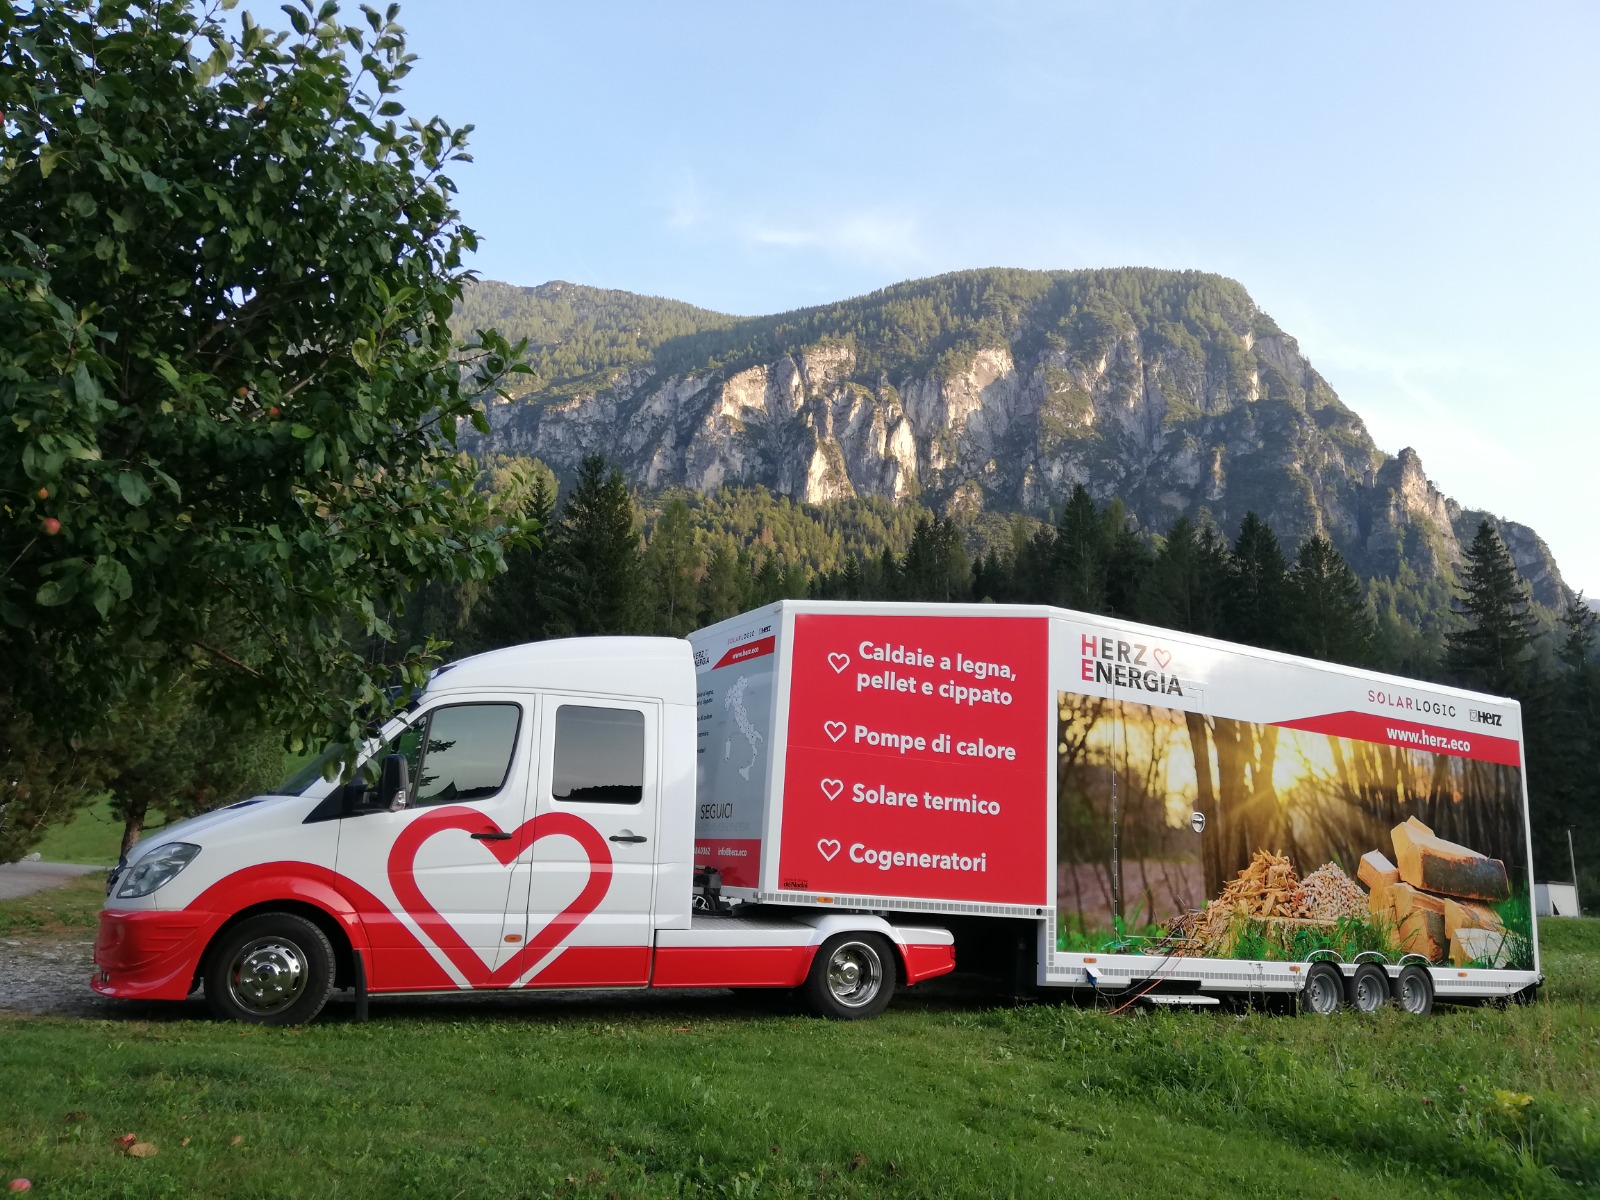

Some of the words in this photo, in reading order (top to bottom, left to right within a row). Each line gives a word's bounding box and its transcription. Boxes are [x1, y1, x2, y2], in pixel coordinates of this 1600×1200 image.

[858, 641, 935, 667] Caldaie
[939, 656, 951, 670] a
[957, 653, 1016, 682] legna,
[1081, 634, 1147, 666] HERZ
[857, 671, 916, 693] pellet
[921, 682, 933, 695] e
[939, 680, 1013, 706] cippato
[1081, 658, 1183, 697] ENERGIA
[1368, 689, 1456, 718] SOLARLOGIC
[854, 725, 926, 754] Pompe
[931, 733, 951, 753] di
[956, 738, 1016, 761] calore
[1386, 727, 1471, 752] www.herz.eco
[700, 802, 733, 819] SEGUICI
[852, 783, 918, 808] Solare
[923, 792, 1000, 815] termico
[849, 843, 987, 872] Cogeneratori
